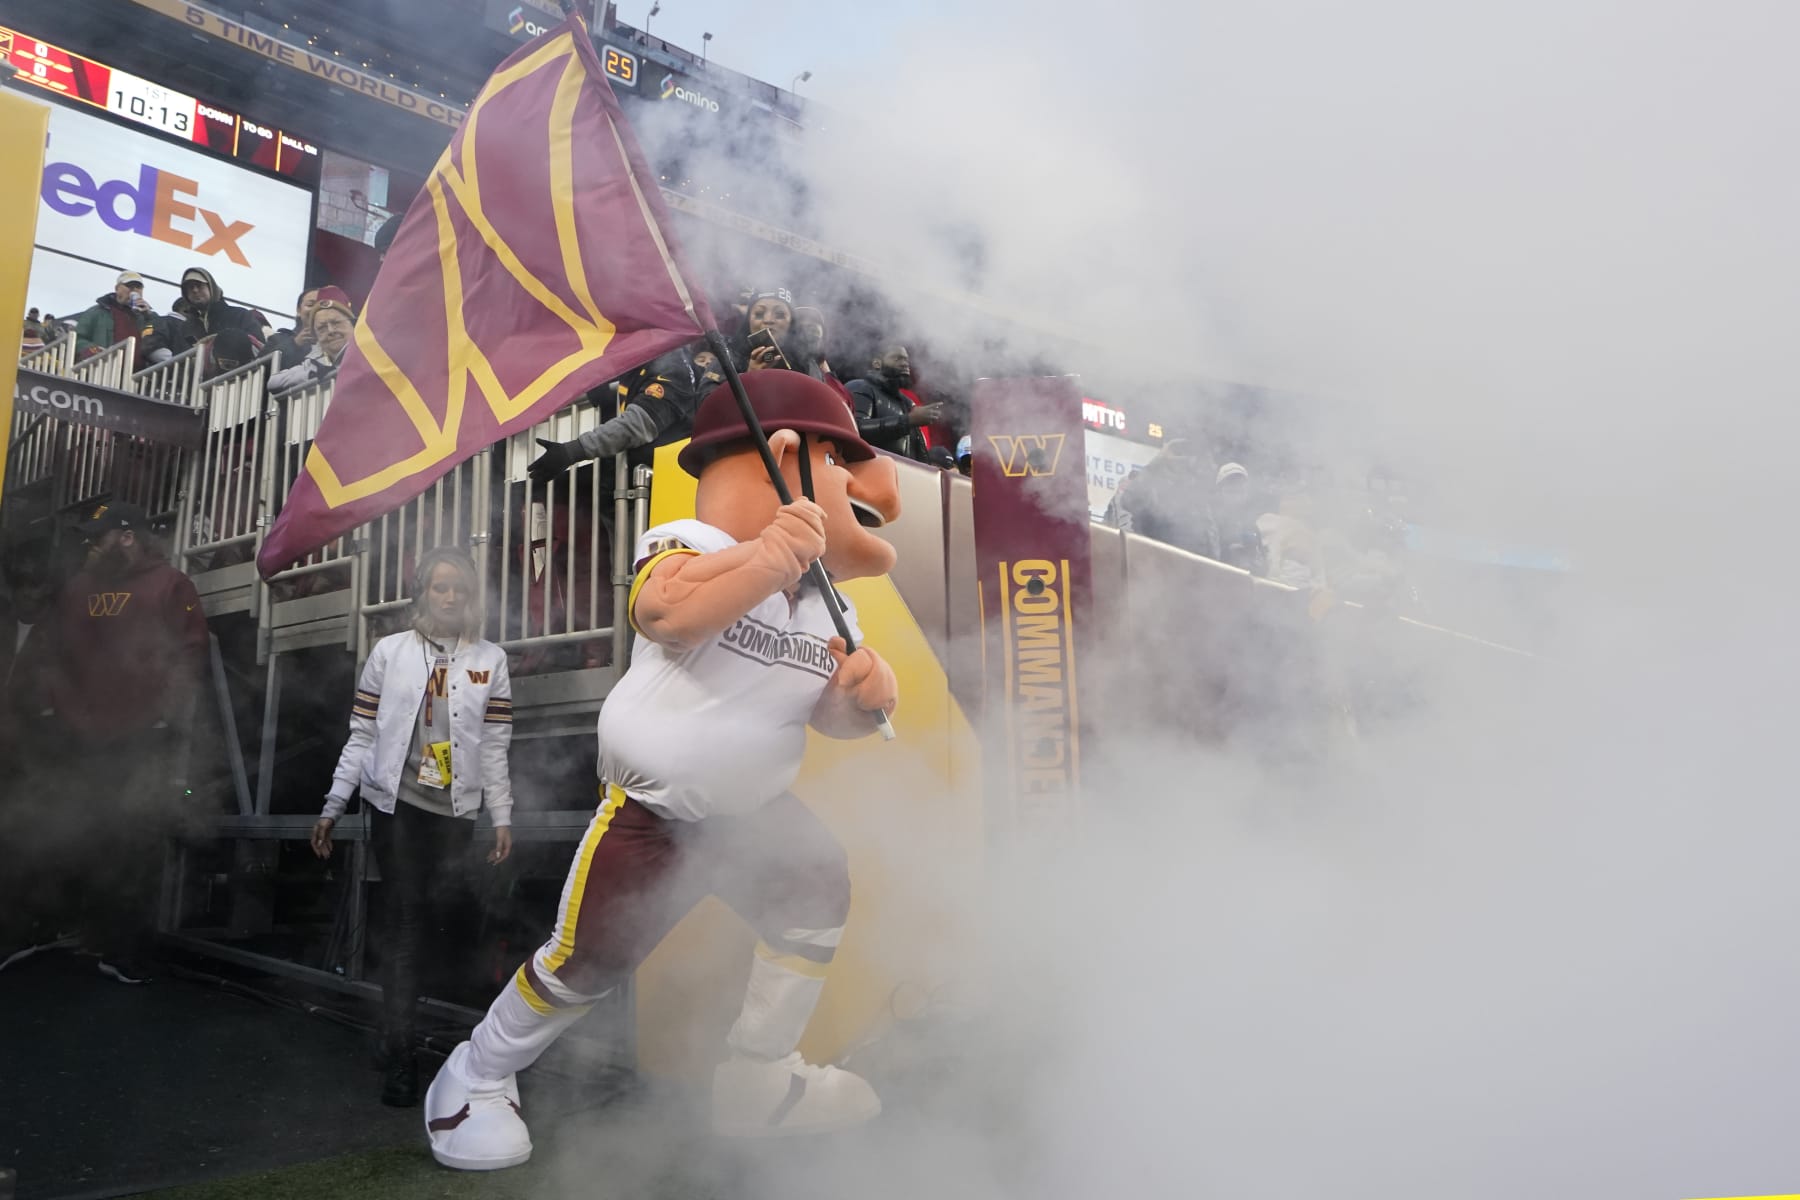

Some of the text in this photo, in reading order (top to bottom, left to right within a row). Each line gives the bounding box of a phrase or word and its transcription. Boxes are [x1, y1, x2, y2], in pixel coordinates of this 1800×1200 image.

[35, 43, 48, 58] 0
[185, 6, 205, 27] 5
[216, 19, 296, 64] TIME
[306, 54, 418, 109] WORLD
[33, 62, 47, 77] 0
[607, 51, 632, 79] 25
[145, 87, 169, 100] 1ST
[675, 86, 720, 113] amino
[115, 91, 189, 132] 10:13
[197, 104, 234, 126] DOWN
[242, 121, 273, 139] TO GO
[281, 136, 318, 155] BALL ON
[41, 133, 255, 268] edEx
[778, 287, 792, 303] 26
[721, 618, 836, 674] COMMANDERS
